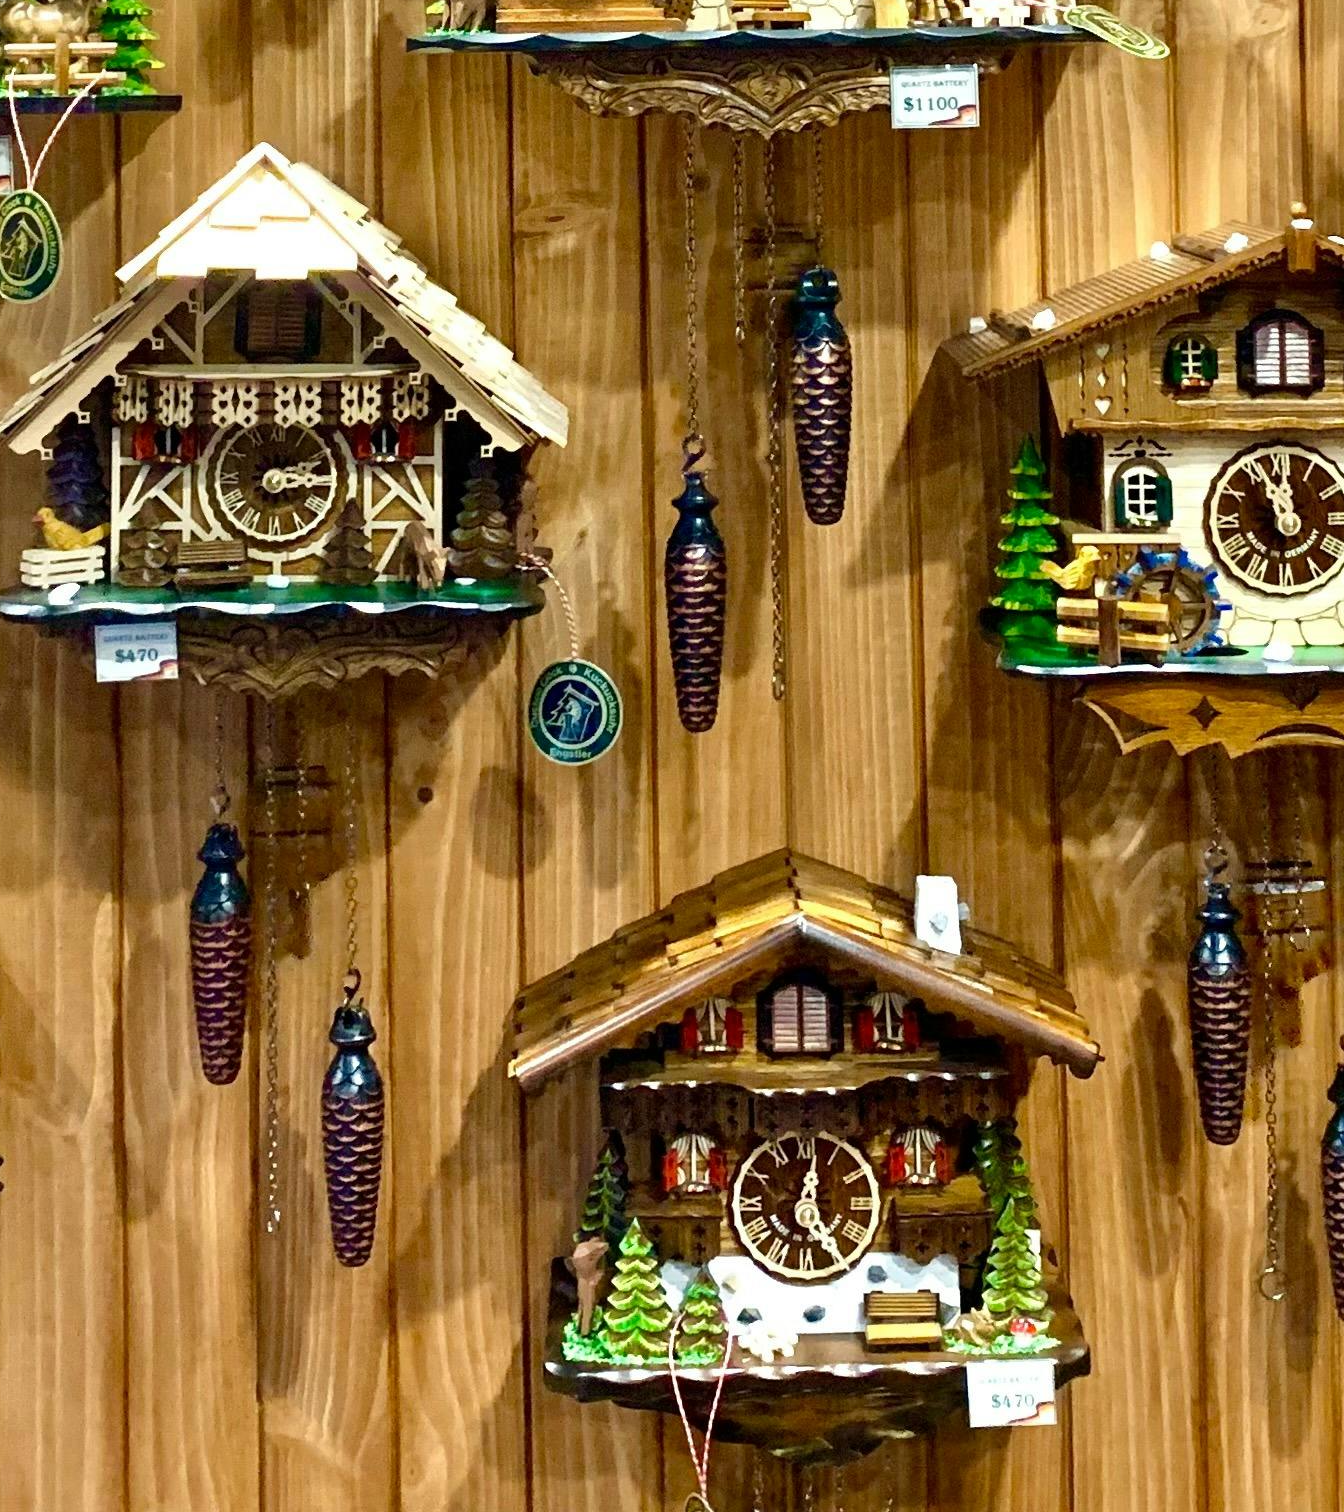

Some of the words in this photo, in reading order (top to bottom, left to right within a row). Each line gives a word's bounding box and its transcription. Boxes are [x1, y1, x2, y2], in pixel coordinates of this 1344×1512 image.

[935, 80, 969, 88] BATTERY
[904, 96, 959, 112] $1100
[1246, 531, 1267, 553] MADE
[1285, 528, 1319, 558] GERMANY
[115, 648, 158, 663] $470
[583, 669, 617, 733] Kuckucksuhr
[549, 748, 591, 758] Engstler
[770, 1215, 790, 1236] MADE
[991, 1393, 1035, 1408] $470
